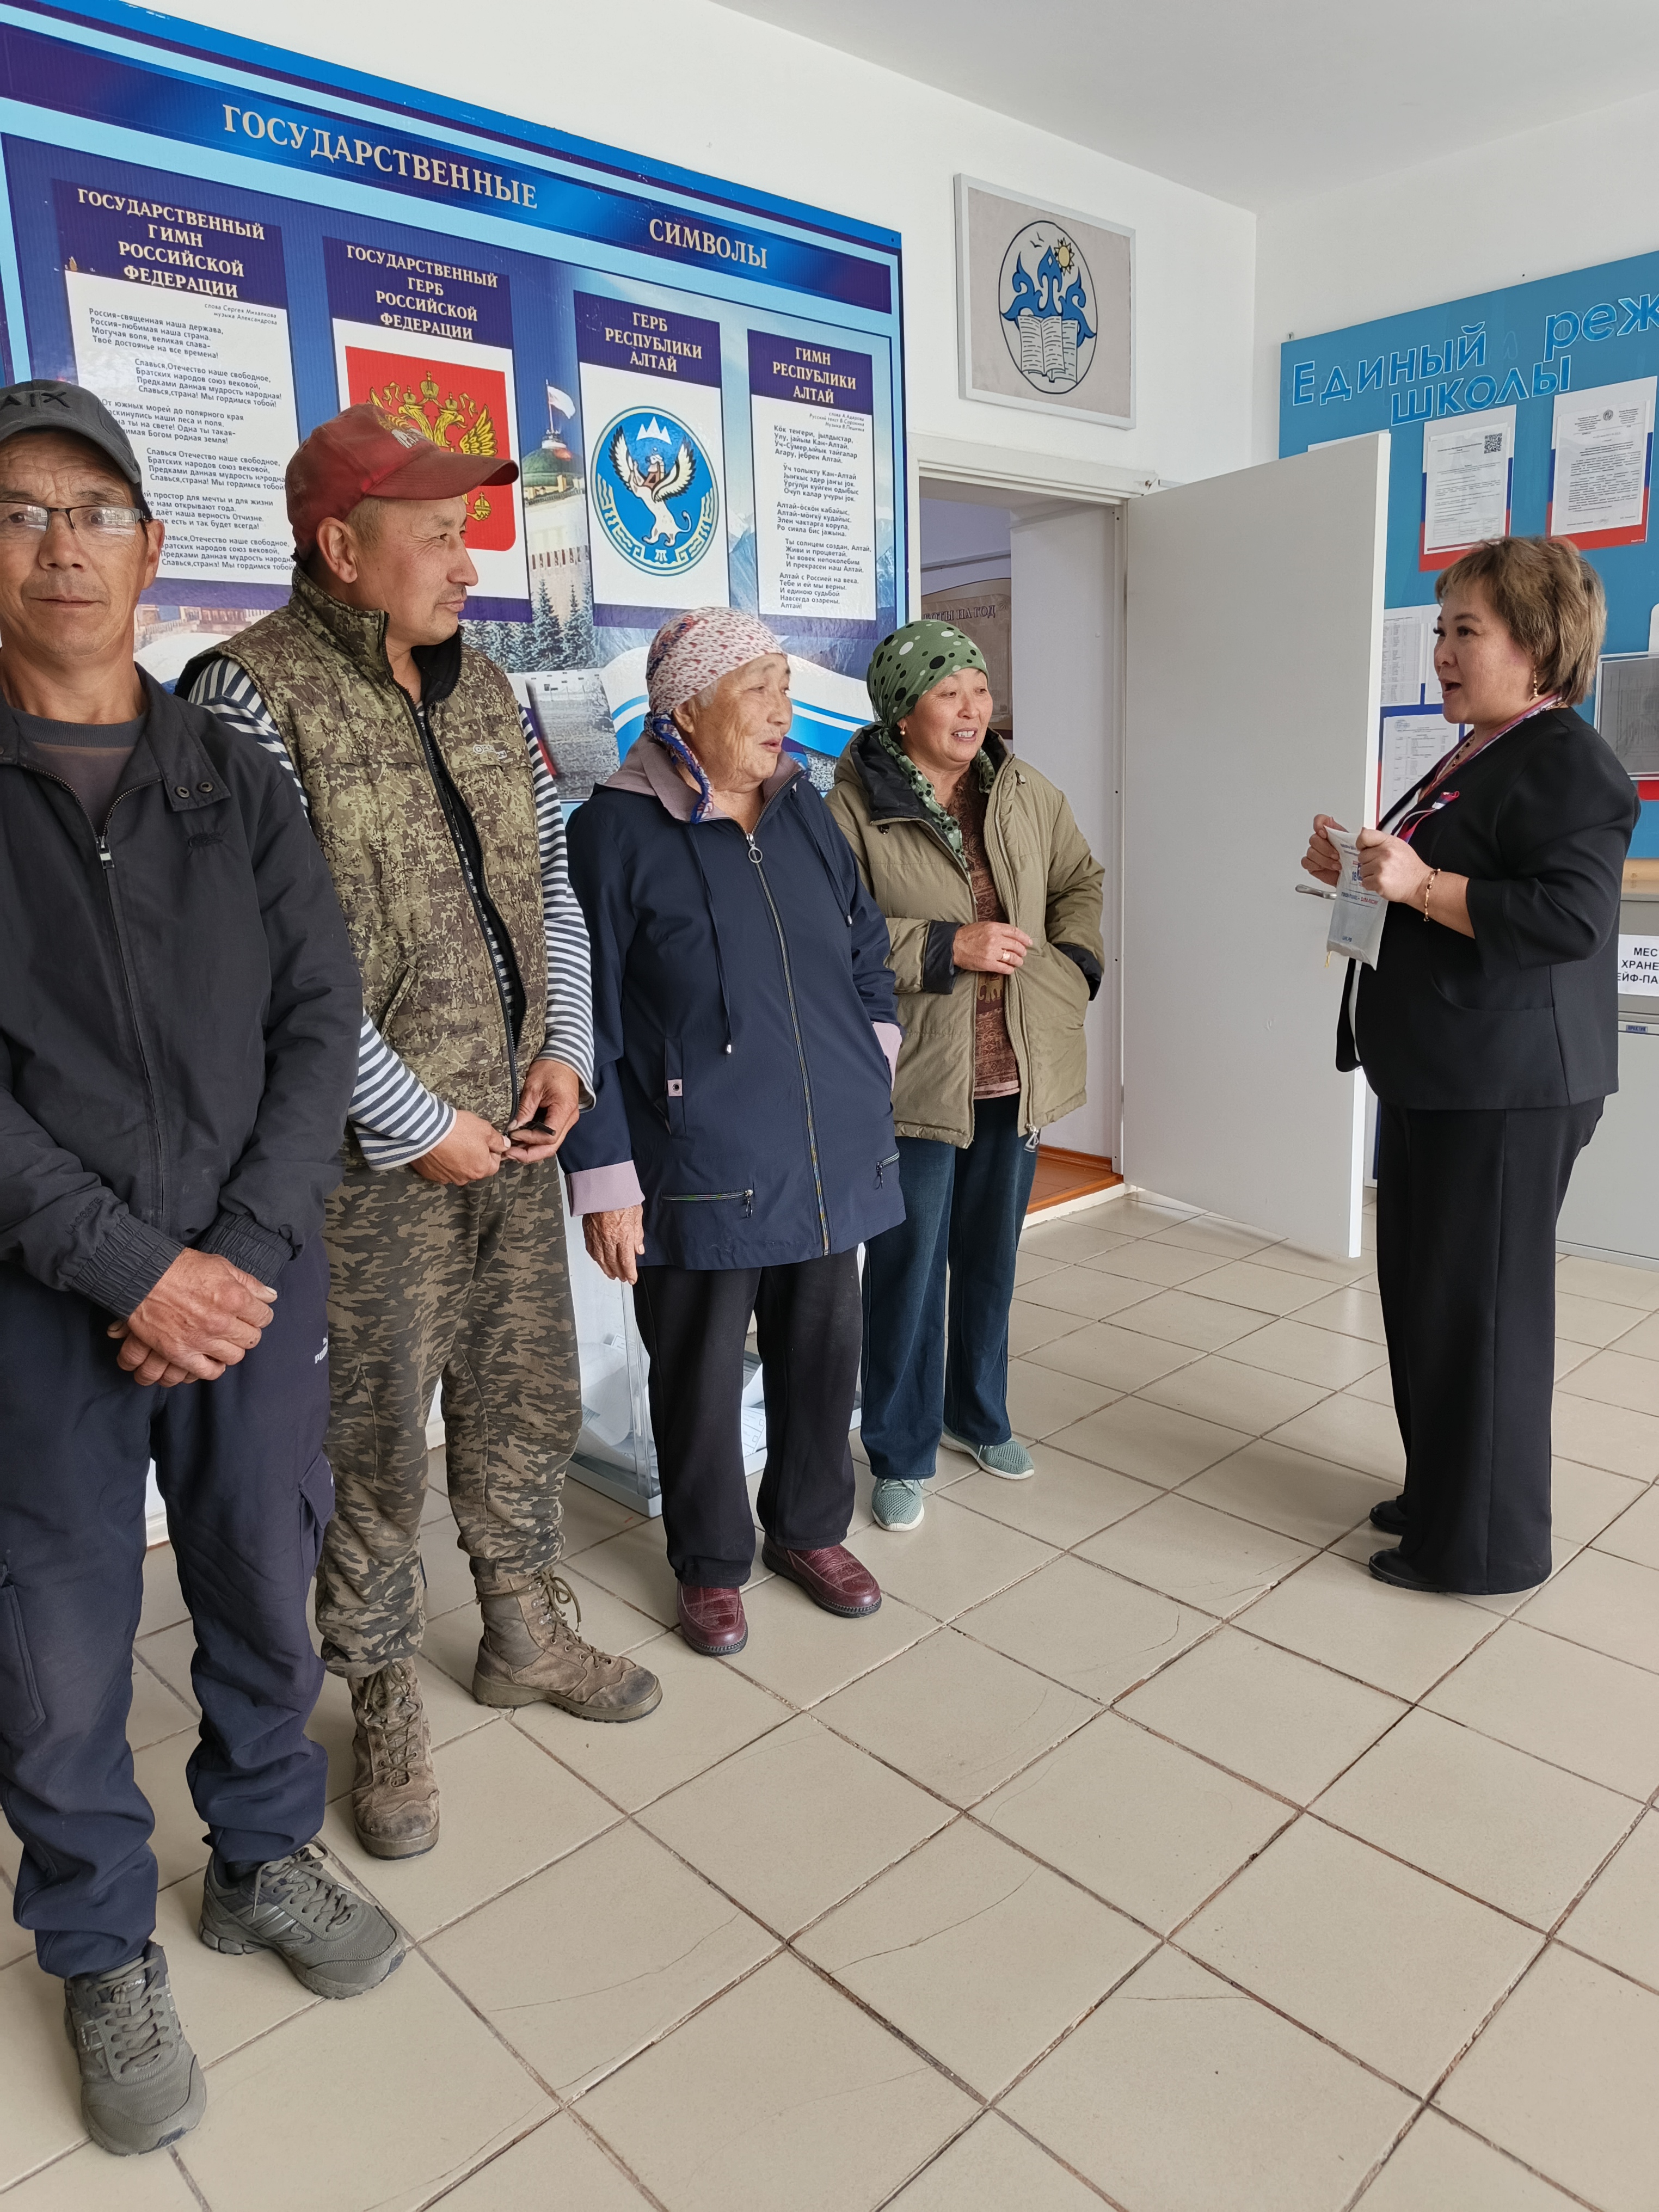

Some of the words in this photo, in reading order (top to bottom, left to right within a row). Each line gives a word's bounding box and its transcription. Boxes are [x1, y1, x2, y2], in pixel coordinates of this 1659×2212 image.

[222, 103, 538, 210] ГОСУДАРСТВЕННЫЕ
[649, 218, 767, 268] СИМВОЛЫ
[77, 188, 266, 241] ГОСУДАРСТВЕННЫЙ
[148, 224, 204, 248] ГИМН
[118, 242, 244, 278] РОССИЙСКОЙ
[347, 244, 497, 288] ГОСУДАРСТВЕННЫЙ
[124, 263, 238, 299] ФЕДЕРАЦИИ
[407, 277, 444, 296] ГЕРБ
[376, 290, 477, 322] РОССИЙСКОЙ
[166, 321, 186, 329] наша
[380, 312, 473, 341] ФЕДЕРАЦИИ
[632, 312, 667, 332] ГЕРБ
[91, 326, 126, 337] Могучая
[152, 336, 183, 346] великая
[605, 328, 702, 359] РЕСПУБЛИКИ
[93, 335, 112, 344] Твоё
[115, 340, 155, 350] достоянье
[184, 349, 218, 359] времена!
[795, 347, 831, 365] ГИМН
[630, 351, 678, 373] АЛТАЙ
[136, 367, 171, 378] Братских
[174, 373, 206, 383] народов
[772, 361, 856, 390] РЕСПУБЛИКИ
[137, 376, 176, 387] Предками
[179, 383, 206, 391] данная
[208, 386, 243, 395] мудрость
[245, 391, 281, 400] народная!
[794, 385, 834, 404] АЛТАЙ
[102, 398, 112, 407] От
[115, 402, 144, 410] южных
[146, 405, 171, 413] морей
[186, 409, 224, 419] полярного
[216, 393, 251, 404] гордимся
[253, 397, 276, 407] тобой!
[109, 410, 152, 419] аскинулись
[148, 429, 172, 438] Богом
[177, 424, 197, 433] Одна
[794, 467, 820, 476] толыкту
[822, 470, 857, 480] Кан-Алтай
[153, 493, 184, 501] простор
[174, 502, 216, 511] открывают
[211, 520, 231, 529] будет
[777, 517, 793, 525] Элен
[795, 520, 824, 528] чактарга
[779, 572, 799, 580] Алтай
[780, 594, 809, 603] Навсегда
[924, 610, 954, 622] БОТЫ
[956, 608, 972, 620] НА
[974, 605, 996, 619] ГОД
[1633, 947, 1659, 957] МЕС
[1617, 971, 1658, 984] ЕЙФ-ПА
